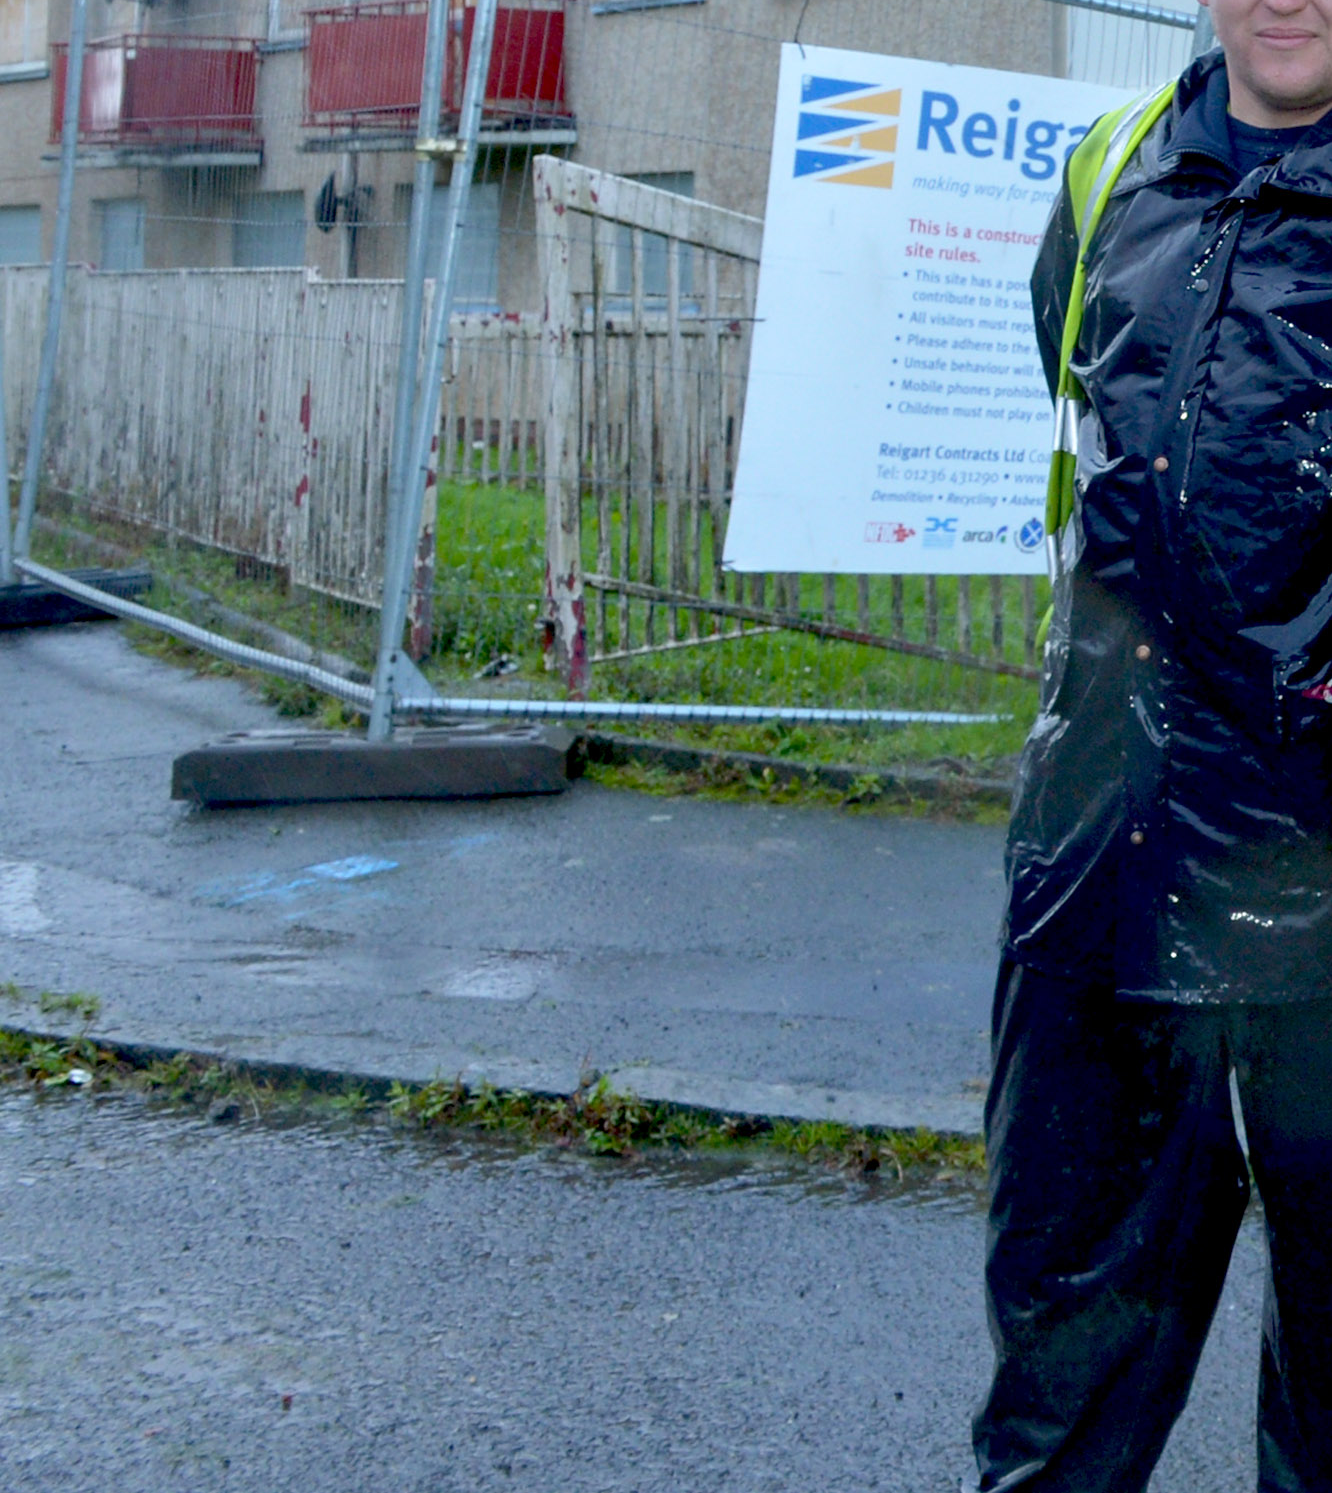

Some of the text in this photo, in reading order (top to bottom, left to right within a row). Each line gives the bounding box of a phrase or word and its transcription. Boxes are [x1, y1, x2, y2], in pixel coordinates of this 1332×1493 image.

[912, 176, 970, 197] making
[975, 185, 1003, 200] way
[1007, 184, 1030, 202] for
[908, 218, 1042, 246] This is a construc
[905, 242, 981, 263] site rules.
[915, 269, 940, 284] This
[945, 272, 968, 286] site
[971, 274, 992, 288] has
[996, 279, 1003, 289] a
[912, 290, 977, 306] contribute
[979, 295, 992, 307] to
[995, 294, 1009, 308] its
[909, 311, 926, 324] All
[930, 313, 974, 328] visitors
[978, 318, 1008, 331] must
[906, 333, 948, 348] Please
[951, 338, 993, 352] adhere
[996, 341, 1008, 353] to
[1011, 341, 1031, 355] the
[904, 357, 946, 371] Unsafe
[950, 361, 1010, 375] behaviour
[1013, 364, 1033, 376] will
[901, 379, 943, 393] Mobile
[947, 382, 990, 396] phones
[897, 400, 949, 415] Children
[952, 405, 982, 418] must
[985, 406, 1004, 419] not
[1007, 407, 1032, 422] play
[879, 442, 930, 461] Reigart
[935, 445, 999, 462] Contracts
[1004, 449, 1025, 463] Ltd
[876, 463, 899, 480] Tel:
[904, 467, 946, 484] 01236
[950, 470, 999, 486] 431290
[871, 489, 934, 503] Demolition
[946, 492, 998, 507] Recycling
[962, 529, 994, 542] arca
